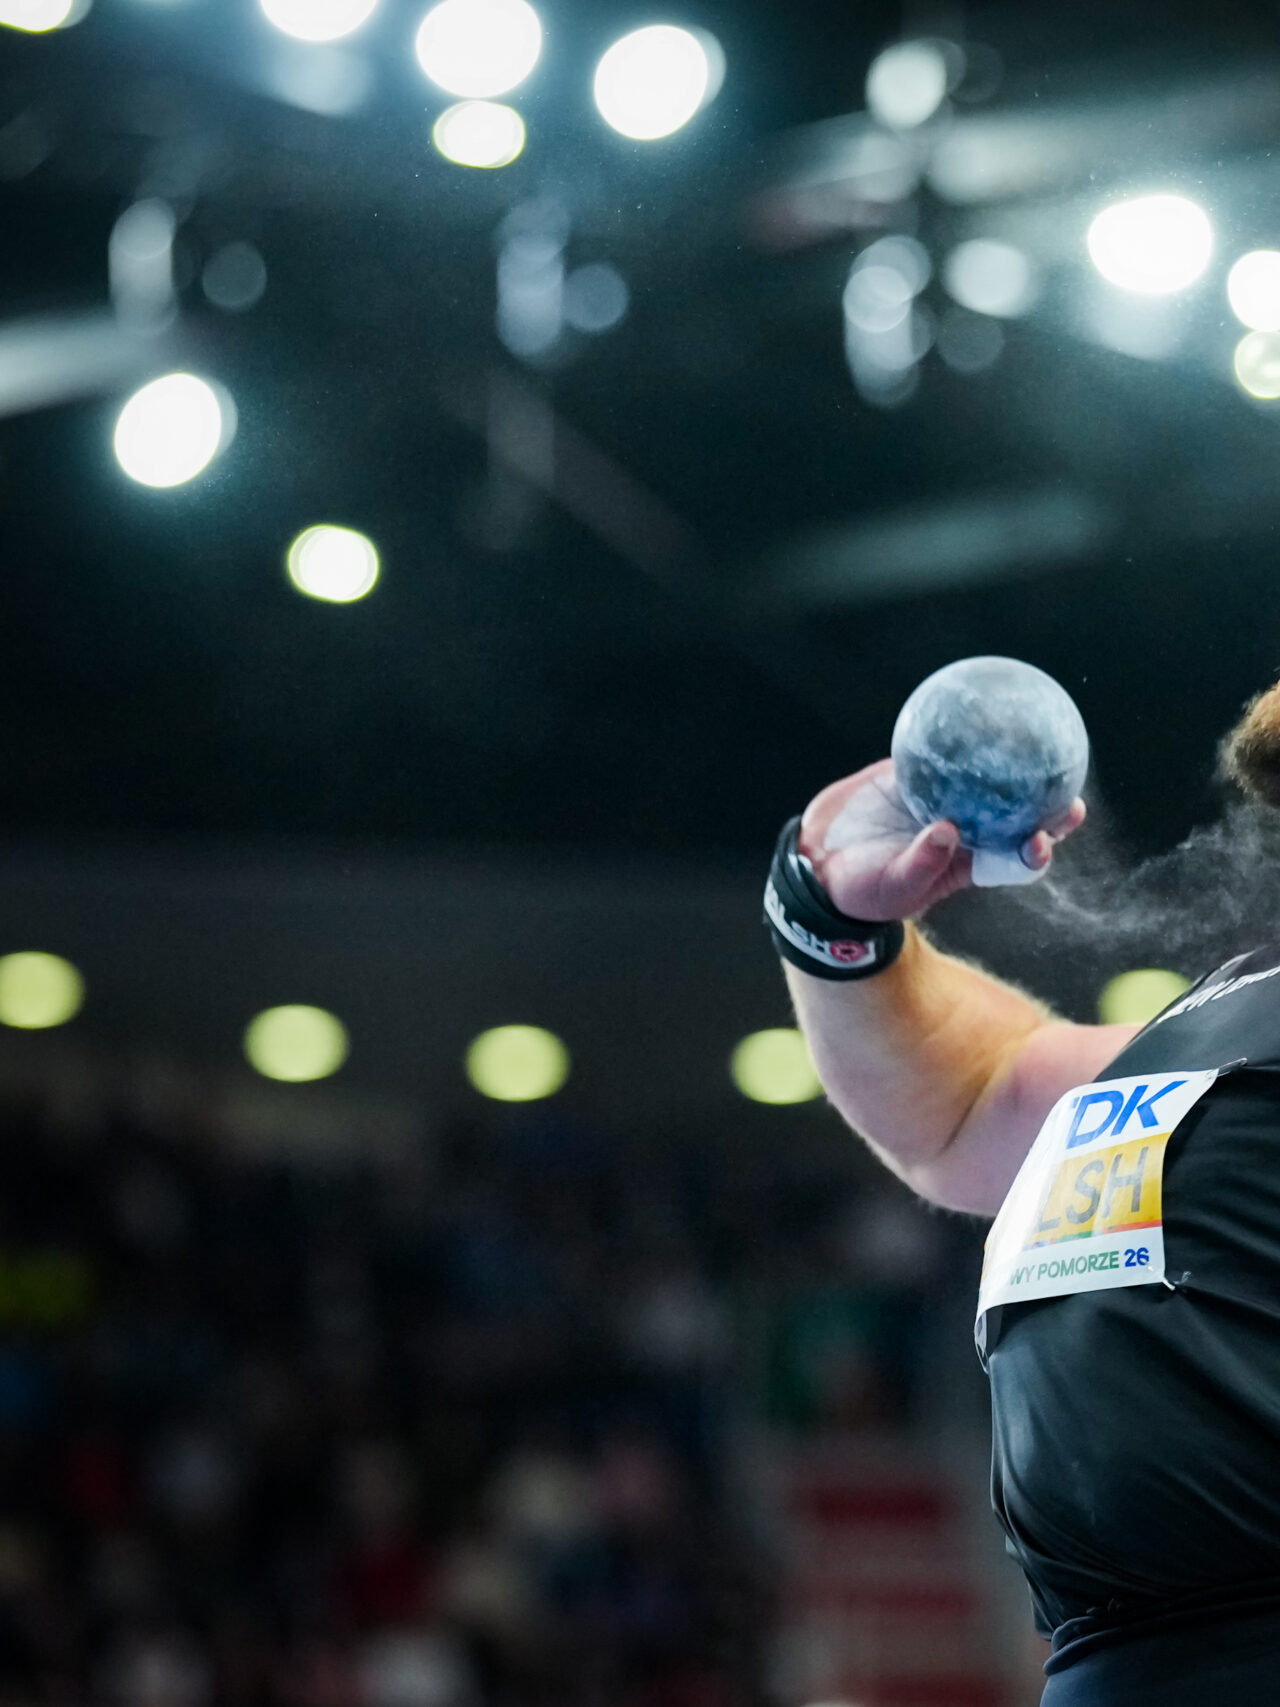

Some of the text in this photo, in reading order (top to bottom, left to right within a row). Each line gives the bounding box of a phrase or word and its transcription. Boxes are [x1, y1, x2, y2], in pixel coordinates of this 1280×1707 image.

[1065, 1079, 1190, 1150] DK
[1037, 1250, 1120, 1279] POMORZE
[1124, 1247, 1150, 1267] 26
